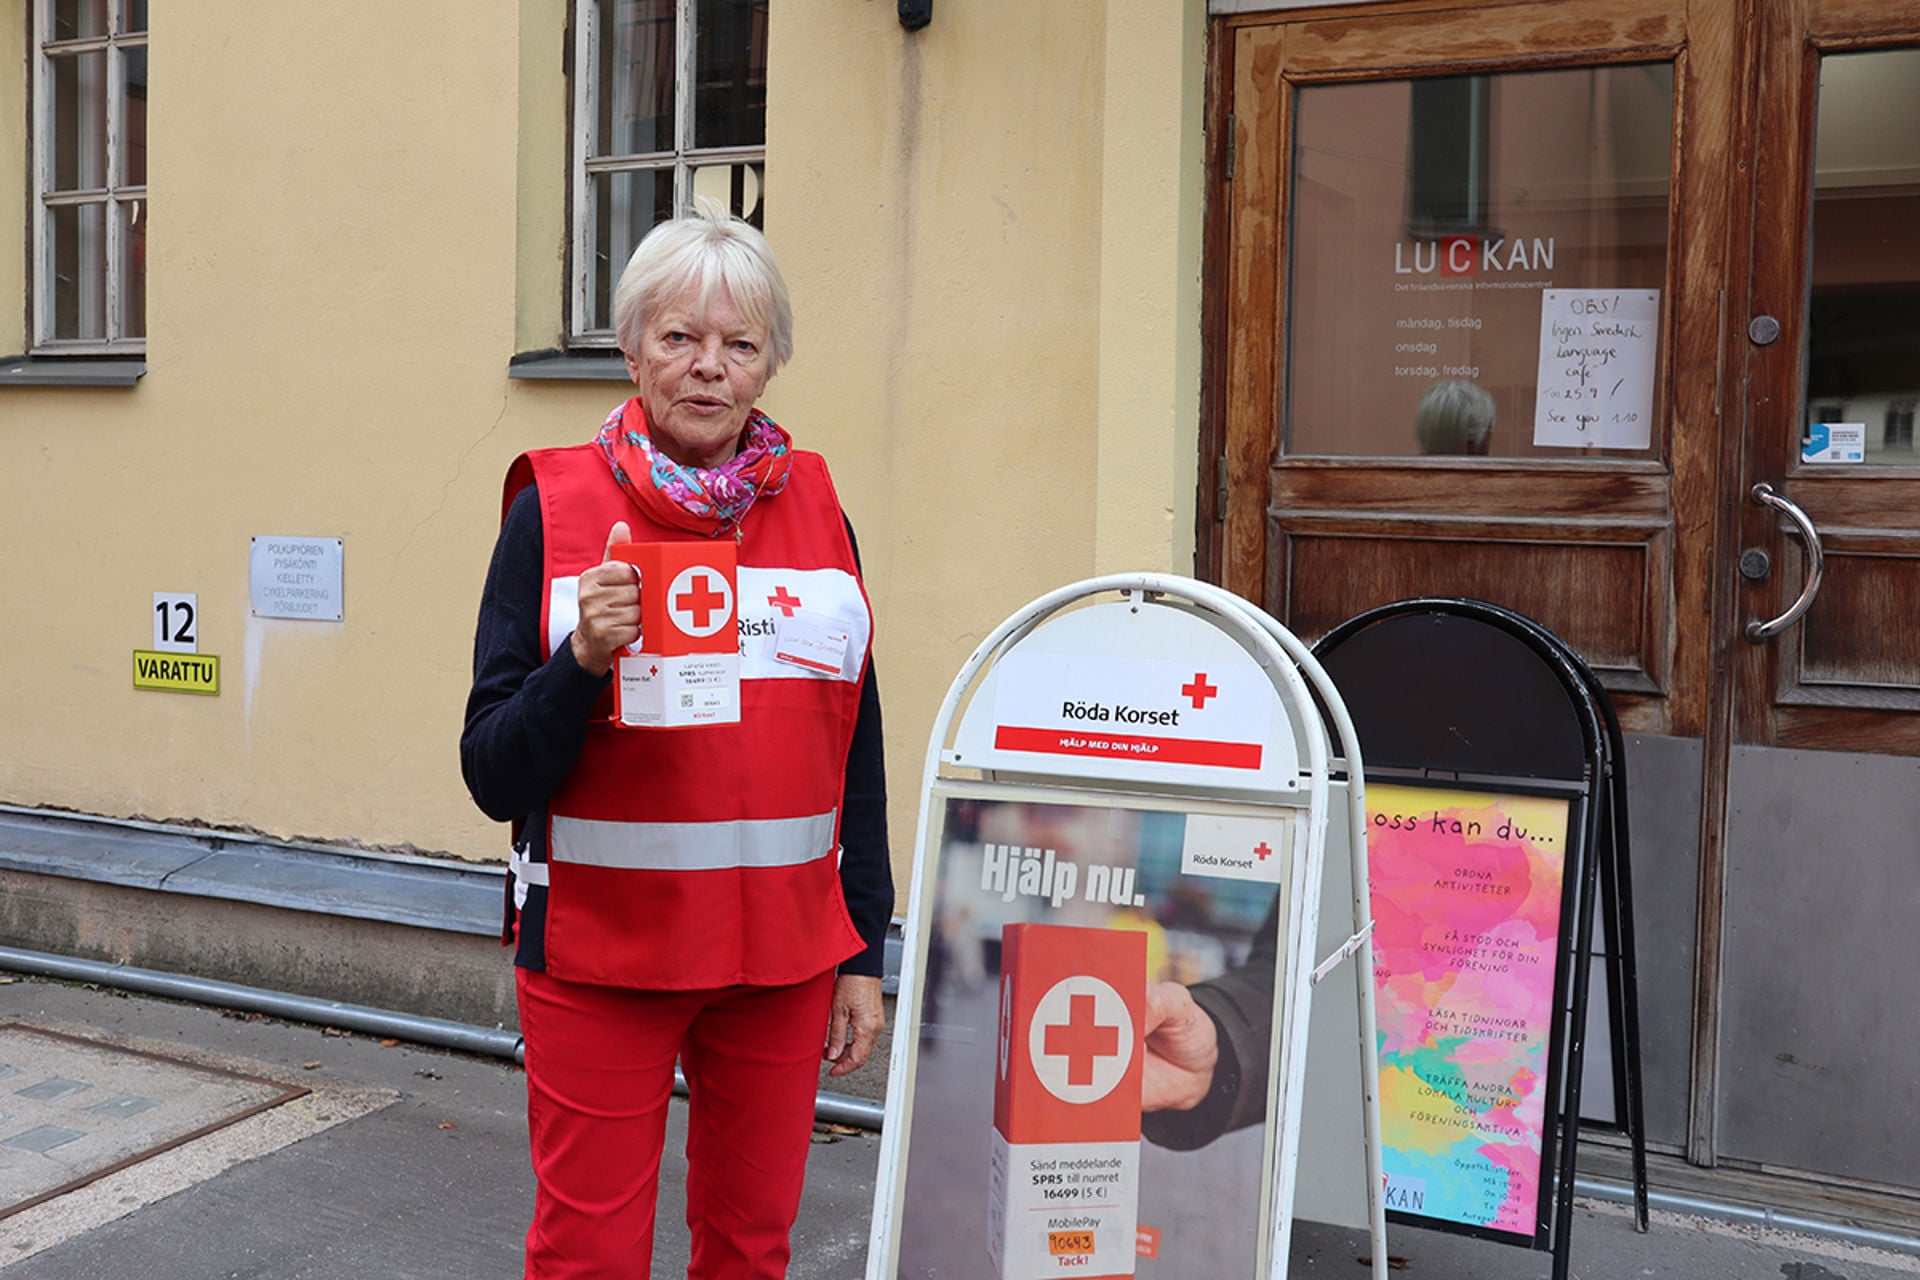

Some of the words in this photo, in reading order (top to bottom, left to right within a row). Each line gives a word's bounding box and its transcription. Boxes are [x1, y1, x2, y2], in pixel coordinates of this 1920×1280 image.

[1395, 238, 1554, 273] LUCKAN
[1570, 296, 1620, 315] OBS!
[1396, 317, 1445, 330] måndag,
[1448, 317, 1482, 330] tisdag
[1395, 342, 1437, 354] onsdag
[1395, 365, 1440, 377] torsdag,
[1443, 365, 1479, 378] fredag
[1576, 414, 1600, 431] you
[277, 573, 315, 584] KIELLETTY
[156, 601, 195, 643] 12
[738, 617, 776, 636] Risti
[138, 658, 213, 683] VARATTU
[1062, 701, 1109, 721] Röda
[1115, 706, 1180, 726] Korset
[1059, 737, 1086, 748] HJÄLP
[1088, 740, 1109, 749] MED
[1111, 742, 1128, 751] DIN
[1130, 743, 1159, 753] HJÄLP
[1374, 813, 1417, 831] oss
[1432, 811, 1481, 835] kan
[1193, 854, 1218, 867] Röda
[1220, 856, 1253, 869] Korset
[981, 843, 1078, 908] Hjälp
[1085, 864, 1145, 906] nu.
[1454, 868, 1494, 880] ORDNA
[1434, 880, 1511, 895] AKTIVITETER
[1496, 938, 1519, 948] OCH
[1423, 943, 1486, 957] SYNLIGHET
[1517, 953, 1539, 964] DIN
[1462, 1013, 1527, 1029] TIDNINGAR
[1425, 1021, 1448, 1032] OCH
[1454, 1025, 1528, 1042] TIDSKRIFTER
[1418, 1087, 1462, 1100] LOKALA
[1472, 1081, 1512, 1095] ANDRA
[1454, 1106, 1477, 1115] OCH
[1030, 1159, 1057, 1171] Sänd
[1059, 1157, 1122, 1169] meddelande
[1032, 1174, 1063, 1186] SPR5
[1066, 1173, 1080, 1183] till
[1082, 1172, 1119, 1183] numret
[1043, 1188, 1079, 1199] 16499
[1384, 1185, 1424, 1210] KAN
[1048, 1217, 1102, 1229] MobilePay
[1057, 1255, 1089, 1267] Tack!
